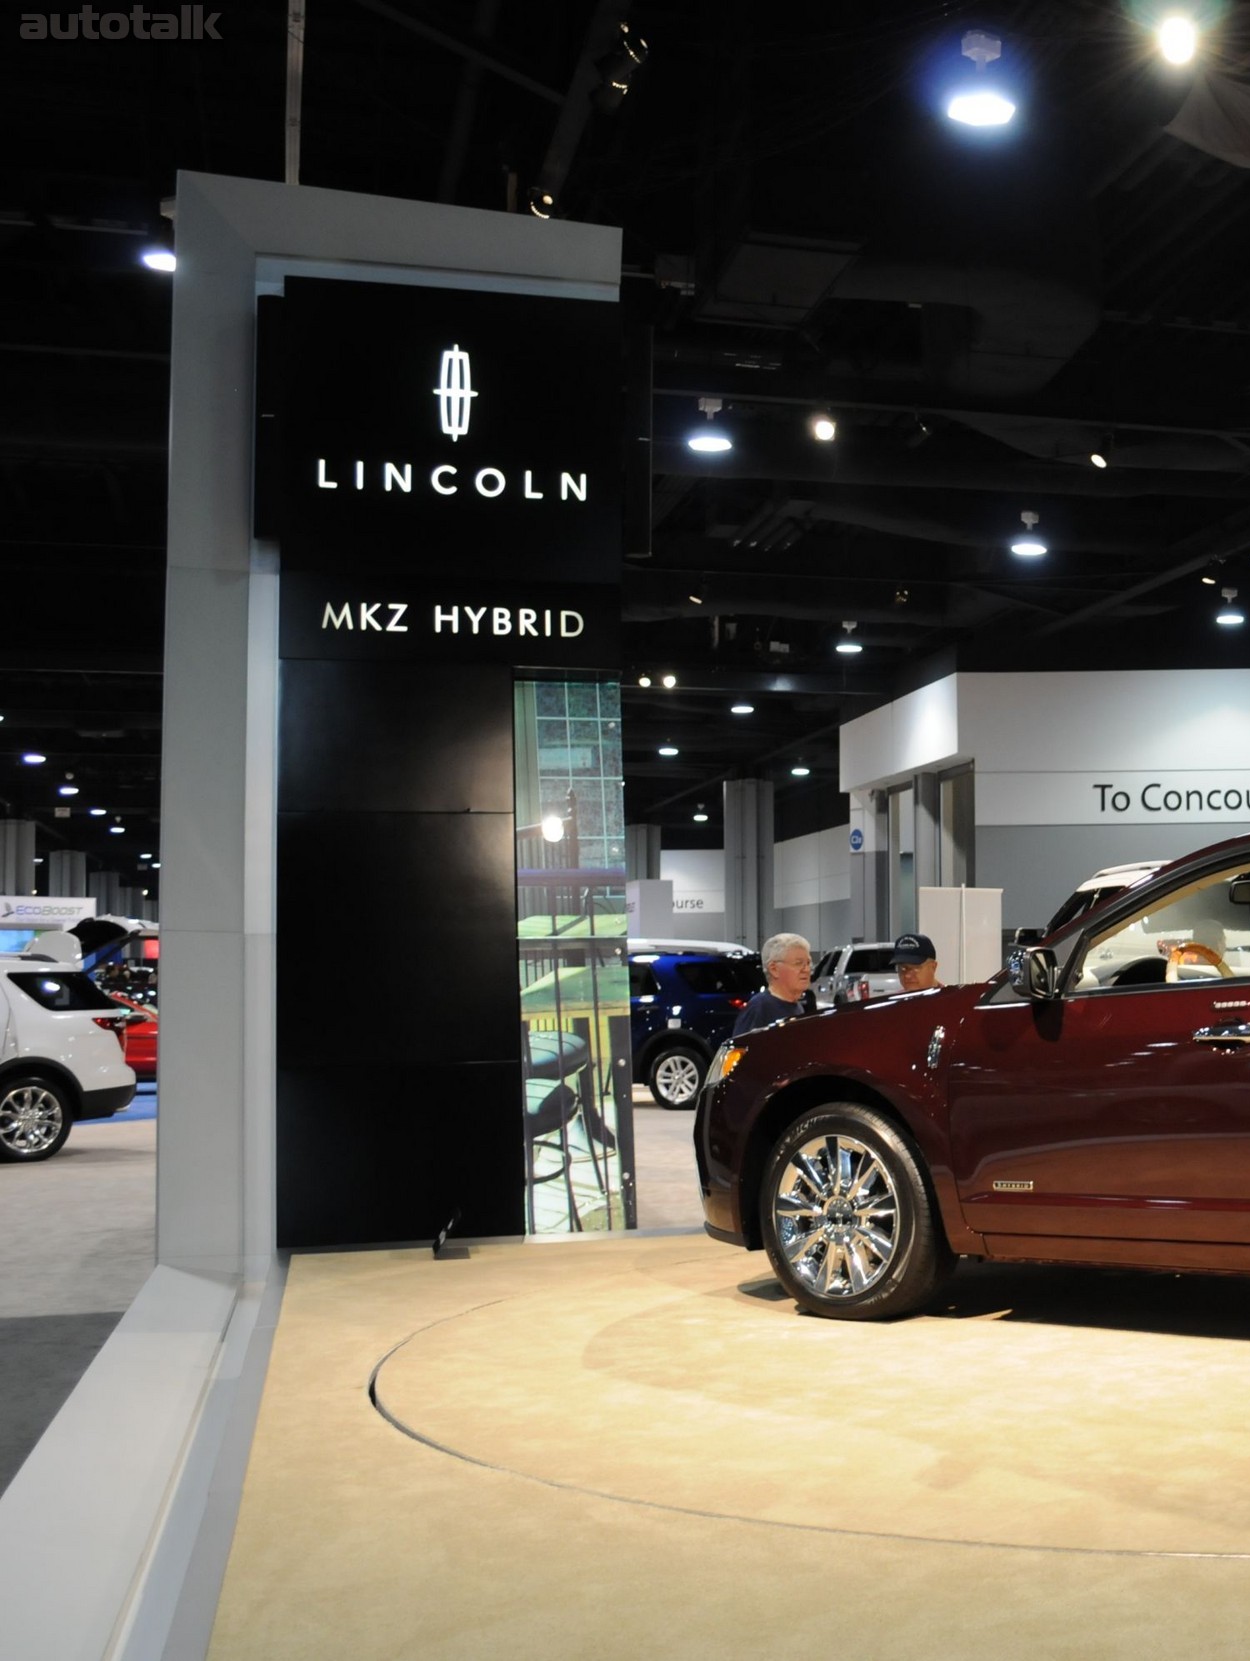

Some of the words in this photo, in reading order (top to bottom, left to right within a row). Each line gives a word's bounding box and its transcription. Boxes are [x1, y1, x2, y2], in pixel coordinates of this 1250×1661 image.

[317, 458, 588, 502] LINCOLN
[321, 601, 409, 633] MKZ
[433, 604, 585, 638] HYBRID
[1092, 783, 1131, 813] To
